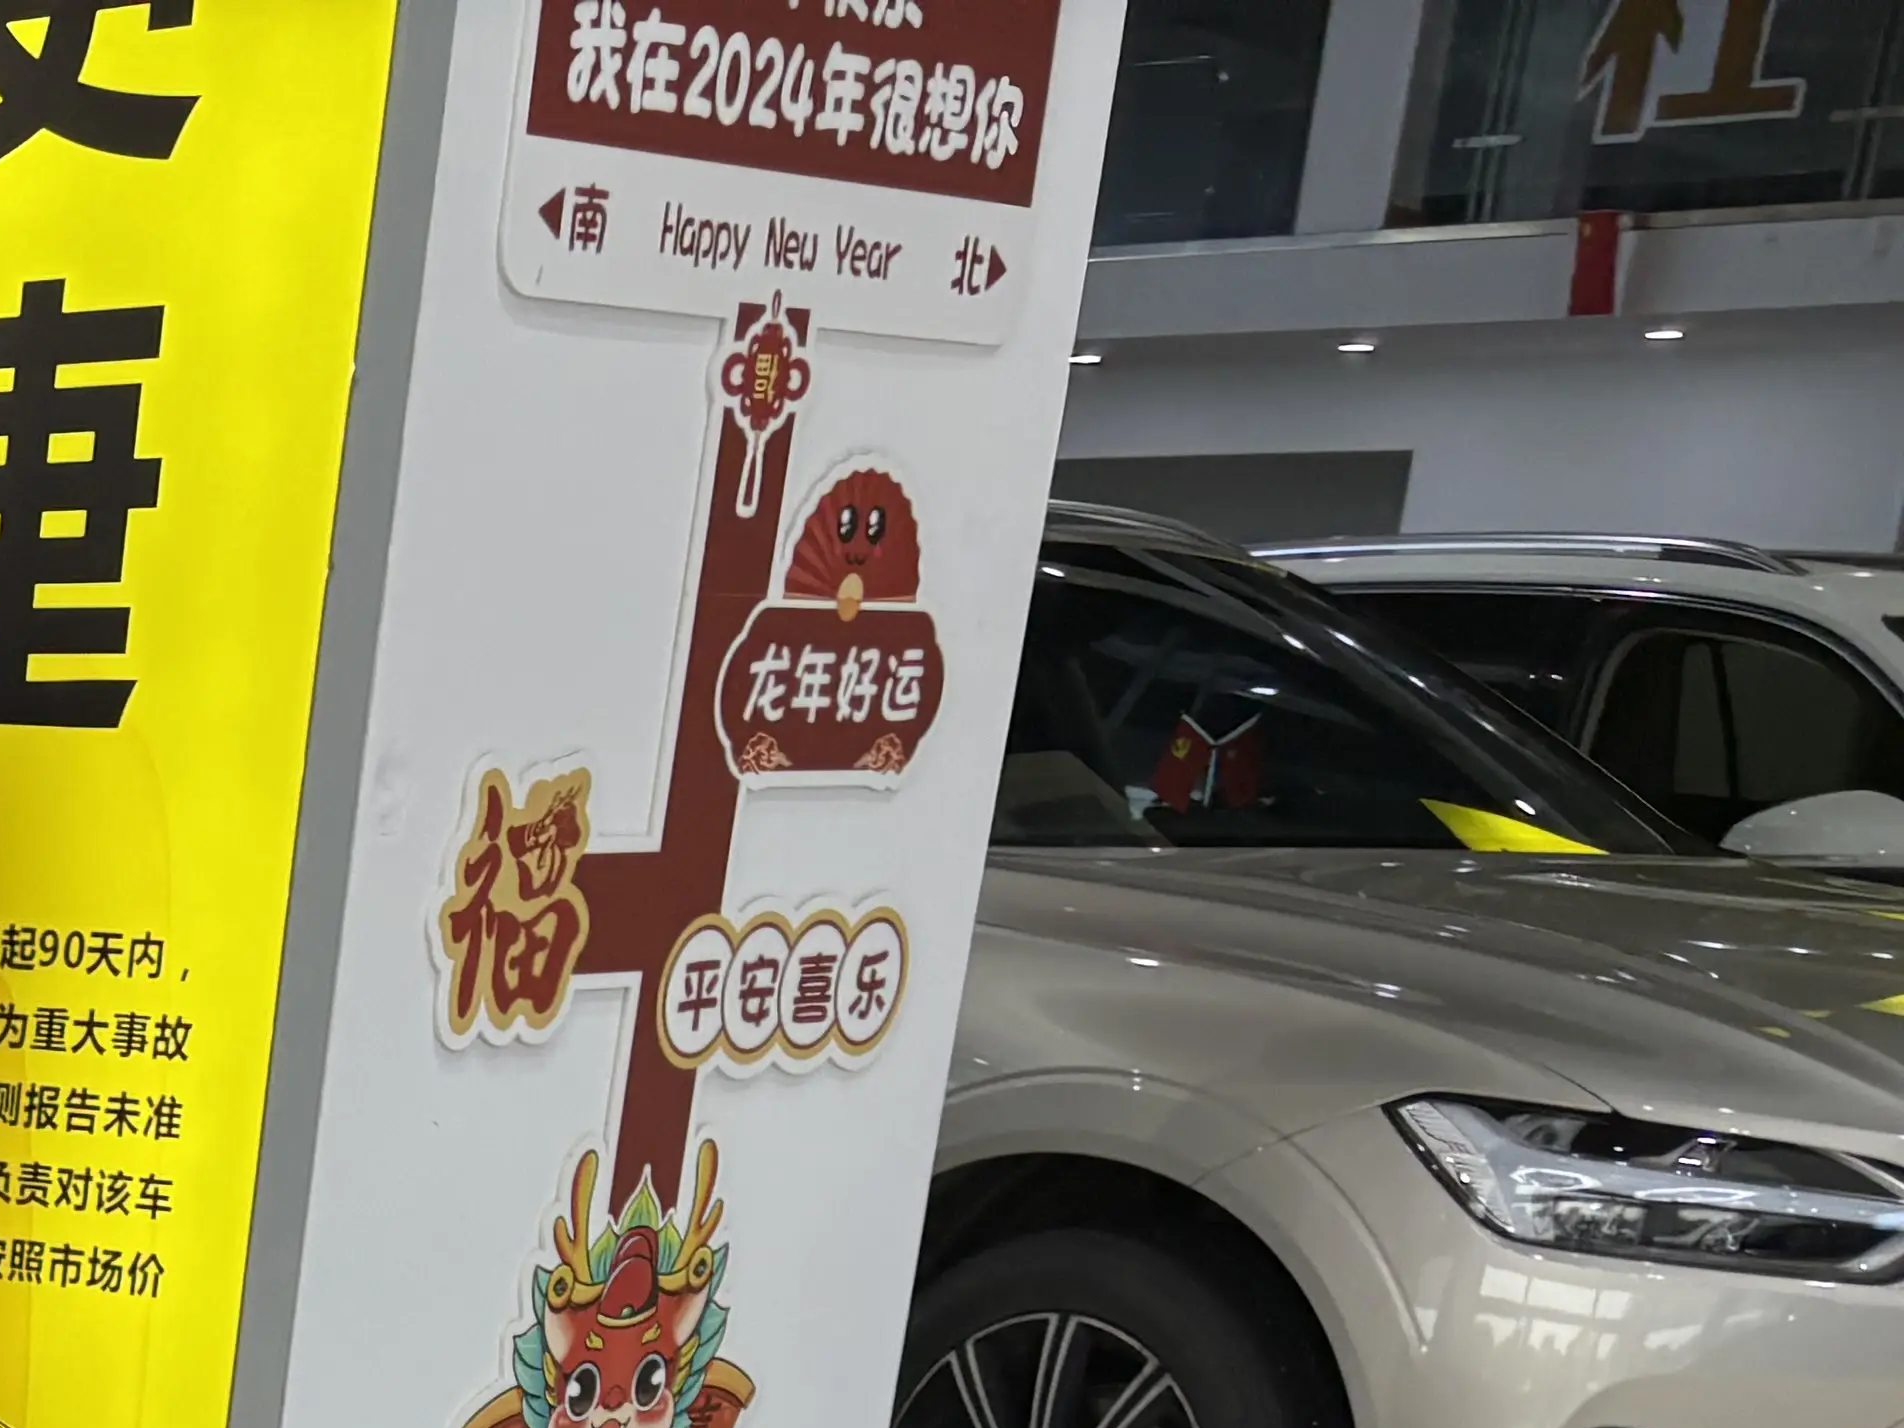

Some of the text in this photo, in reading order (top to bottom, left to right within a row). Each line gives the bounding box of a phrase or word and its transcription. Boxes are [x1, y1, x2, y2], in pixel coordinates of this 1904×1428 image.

[566, 2, 1025, 170] 我在2024年很想你
[568, 183, 983, 297] 南 Happy New Year 北
[743, 642, 925, 724] 龙年好运
[676, 949, 891, 1031] 平安喜乐
